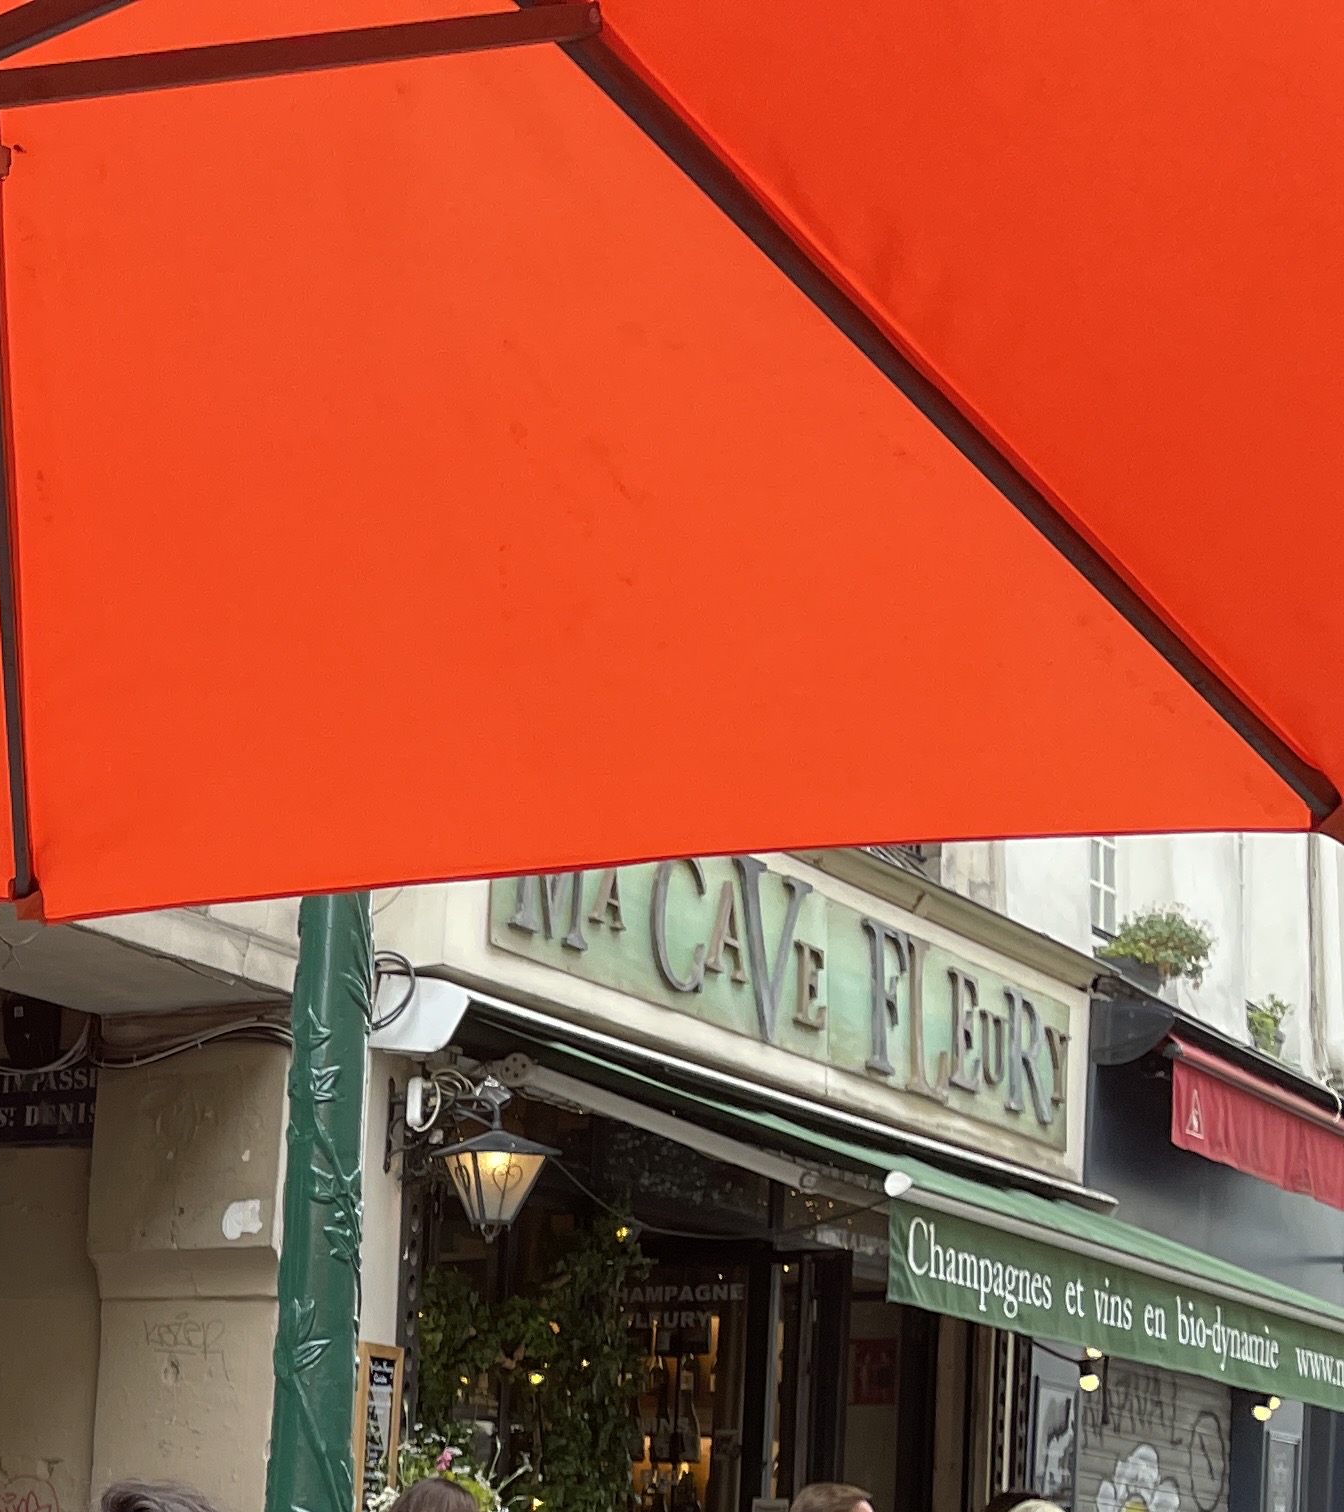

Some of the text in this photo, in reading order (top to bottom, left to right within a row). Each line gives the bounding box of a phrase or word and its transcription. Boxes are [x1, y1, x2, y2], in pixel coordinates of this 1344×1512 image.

[649, 853, 828, 1046] CAVE
[861, 917, 1071, 1126] FLEURY
[616, 1282, 746, 1303] HAMPAGNE
[907, 1216, 1053, 1319] Champagnes
[1065, 1278, 1086, 1318] et
[1094, 1276, 1133, 1331] vins
[1144, 1302, 1168, 1341] en
[1176, 1295, 1280, 1372] bio-dynamie
